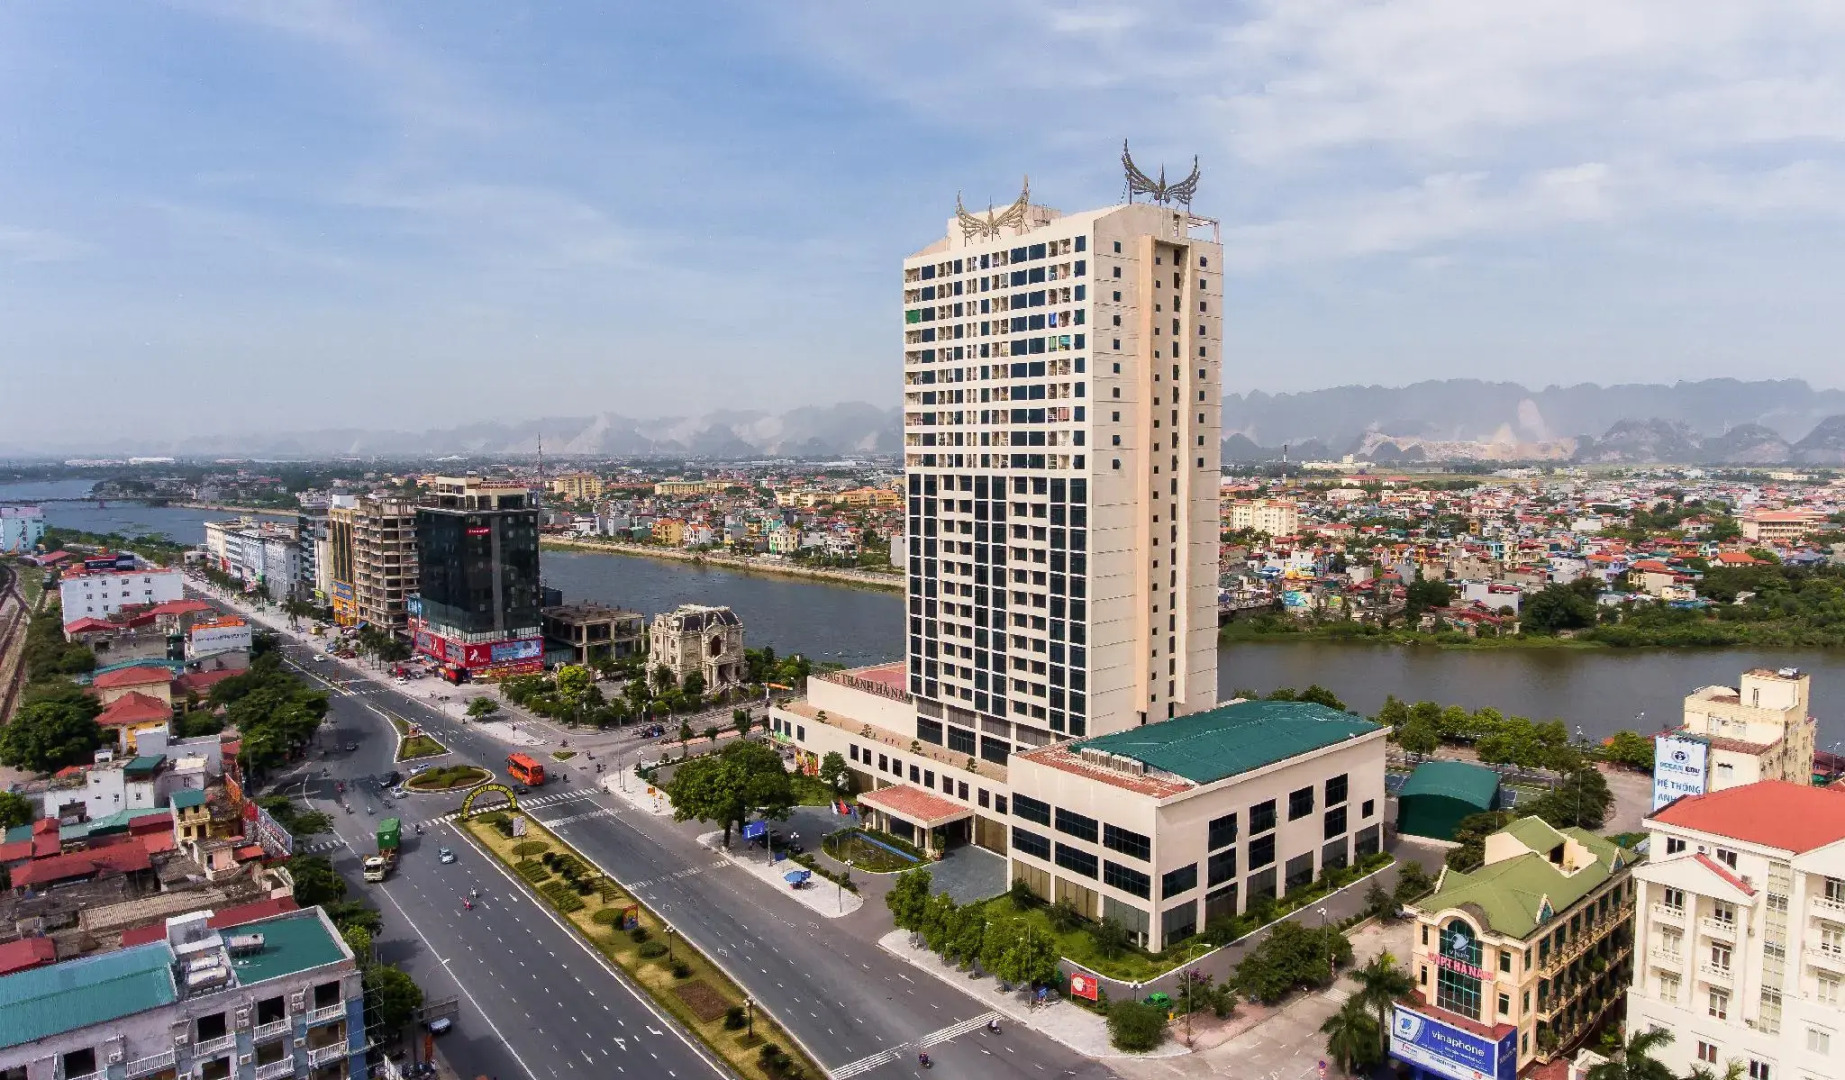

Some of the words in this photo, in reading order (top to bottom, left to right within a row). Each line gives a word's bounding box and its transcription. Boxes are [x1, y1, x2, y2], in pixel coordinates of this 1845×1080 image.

[841, 673, 874, 692] THANH
[875, 681, 890, 697] HÀ
[1660, 761, 1683, 771] OCEAN
[1657, 779, 1668, 789] HỆ
[1670, 781, 1701, 794] THỐNG
[1431, 1030, 1485, 1057] vinaphone
